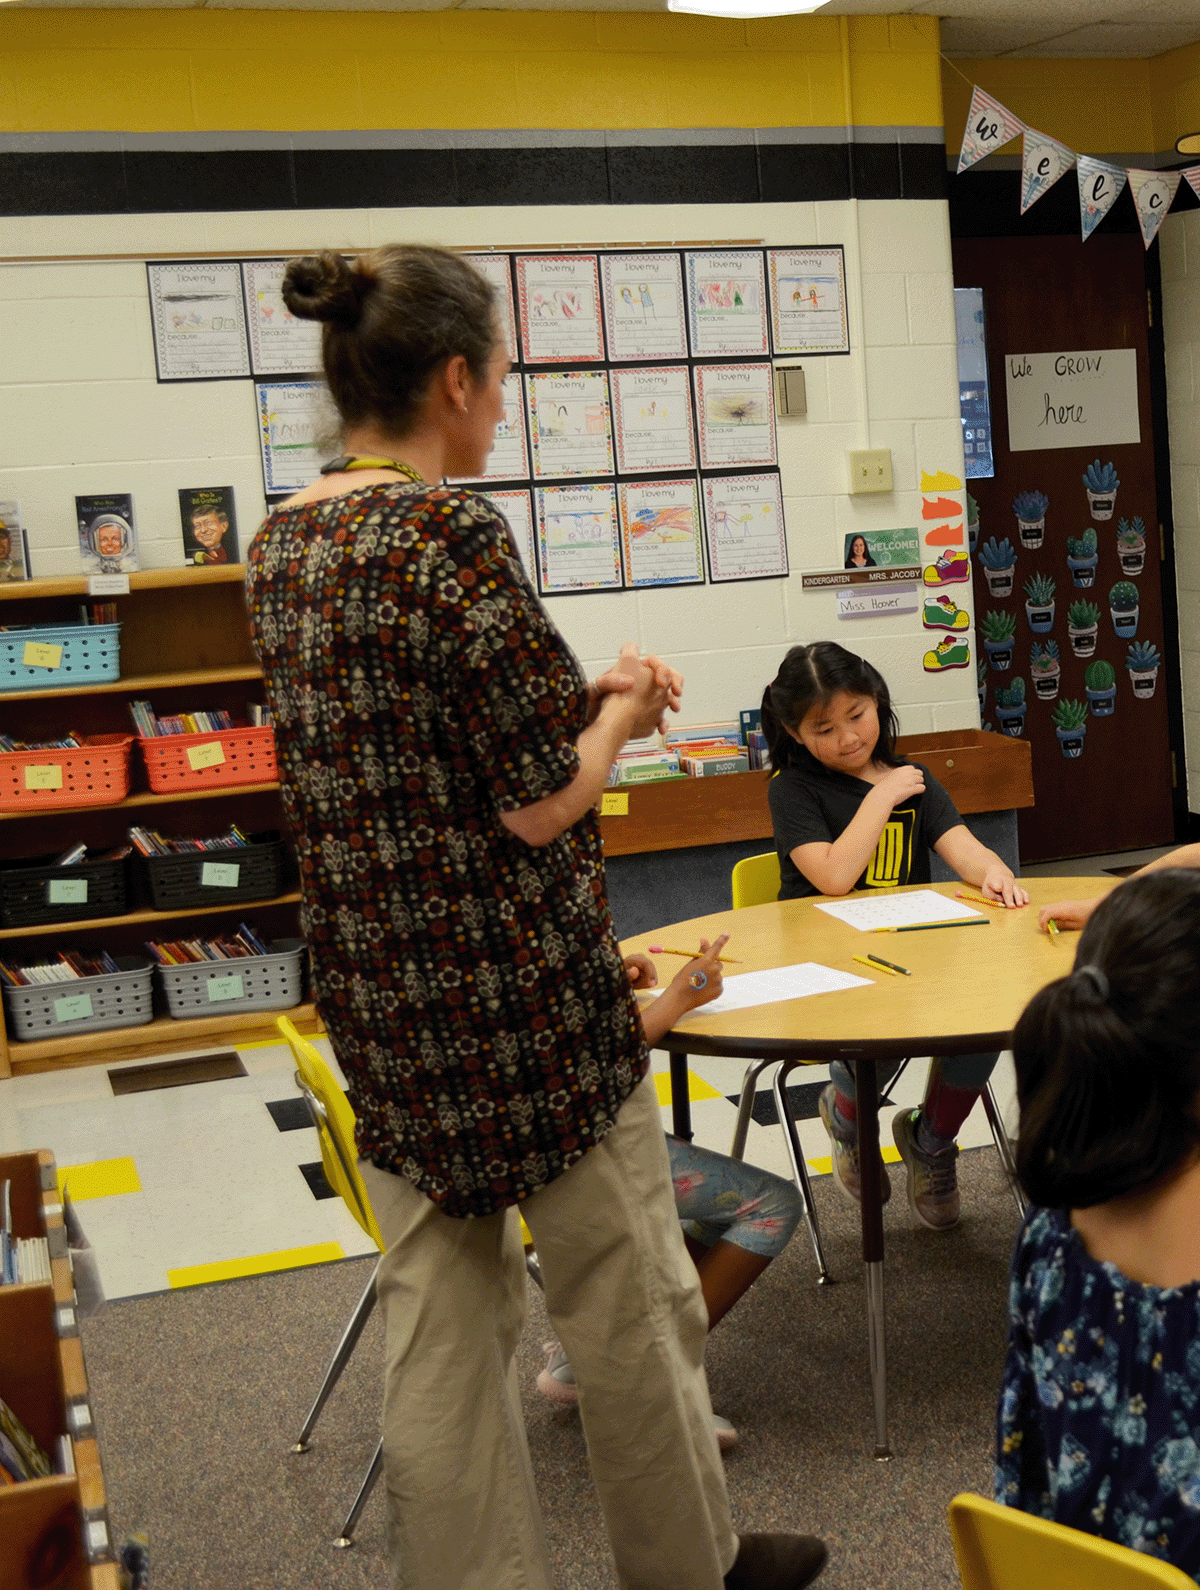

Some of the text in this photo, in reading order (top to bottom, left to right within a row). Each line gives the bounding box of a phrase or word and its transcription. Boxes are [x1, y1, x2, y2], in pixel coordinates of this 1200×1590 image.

[713, 260, 728, 268] love
[793, 258, 808, 266] love
[544, 264, 560, 272] love
[629, 263, 644, 272] love
[182, 274, 200, 282] love
[1010, 355, 1102, 379] We GROW
[638, 376, 652, 384] love
[287, 390, 304, 400] love
[1037, 392, 1088, 428] here
[562, 494, 578, 502] love
[645, 490, 662, 498] love
[868, 540, 919, 552] WELCOME!
[803, 570, 921, 586] KINDERGARTEN MRS. JACOBY
[840, 598, 900, 613] Miss Hoover
